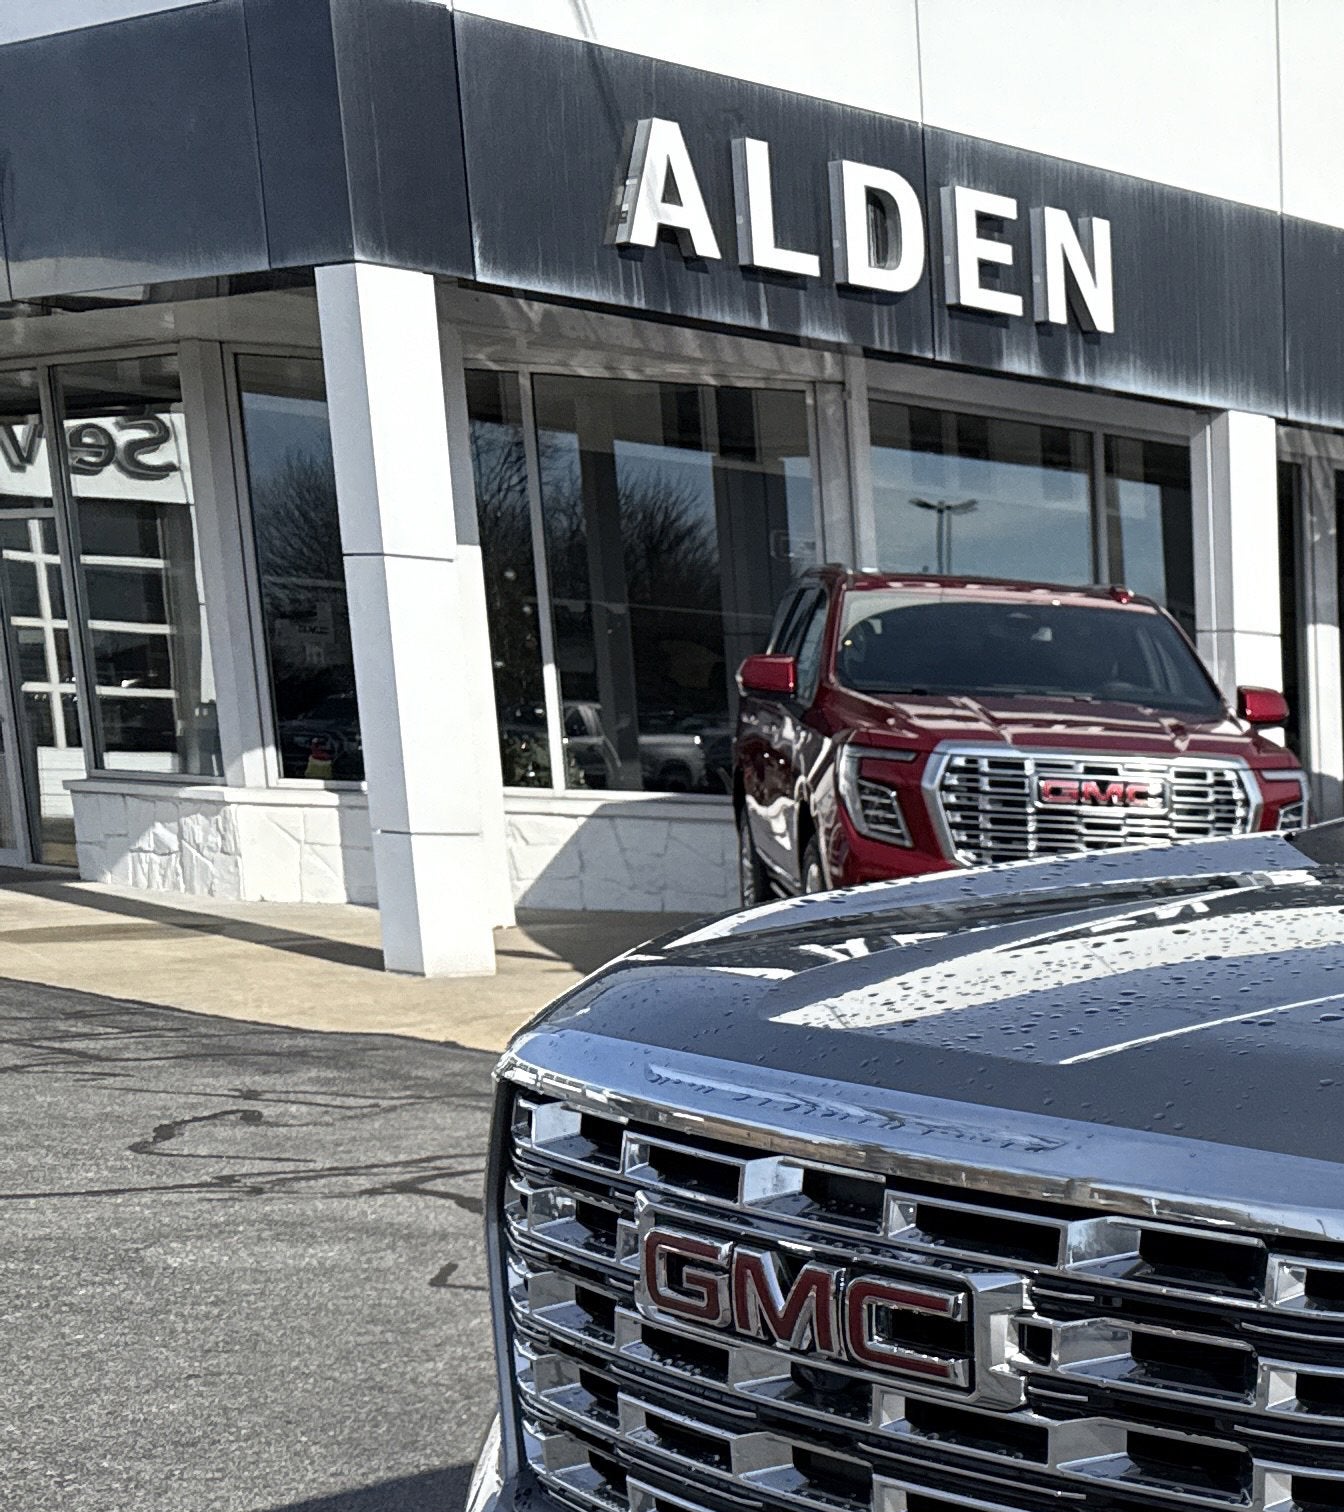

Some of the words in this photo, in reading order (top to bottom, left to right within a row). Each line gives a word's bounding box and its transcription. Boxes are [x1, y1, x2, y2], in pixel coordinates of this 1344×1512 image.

[619, 117, 1115, 333] ALDEN
[1039, 779, 1163, 808] GMC
[640, 1227, 969, 1388] GMC
